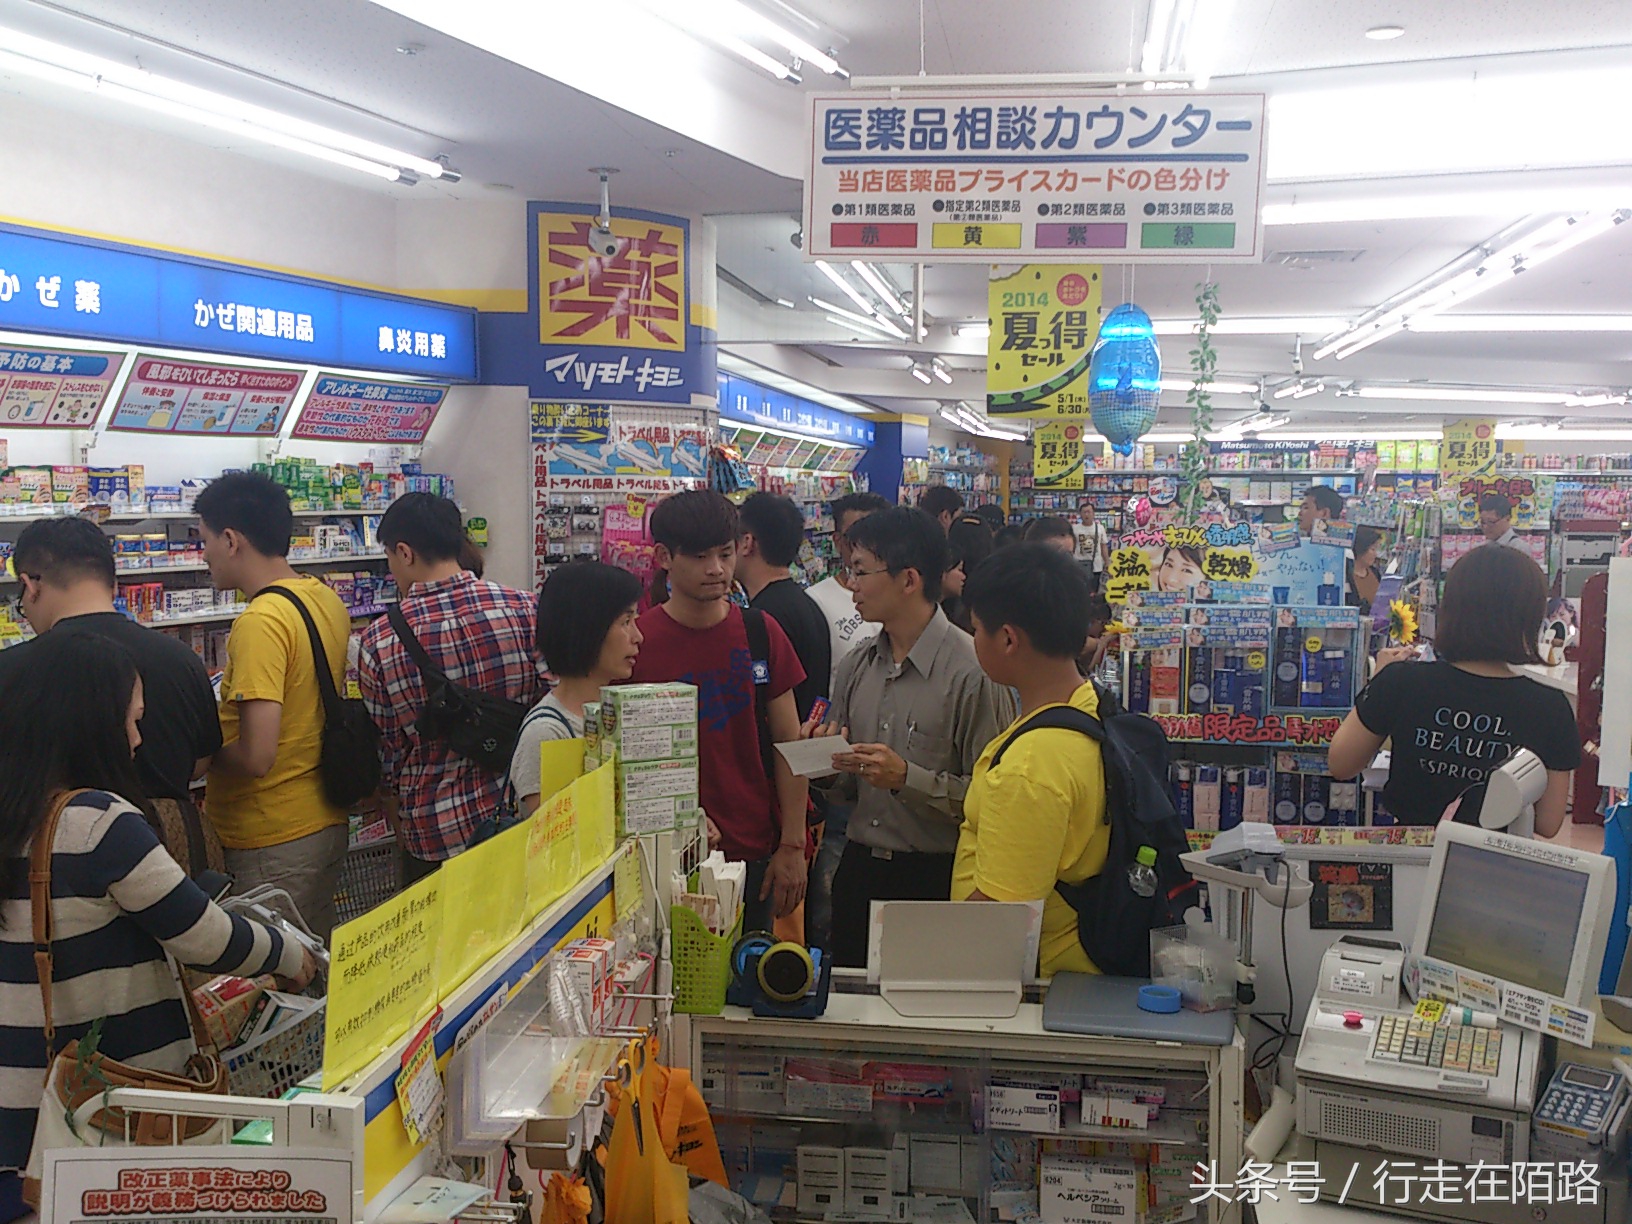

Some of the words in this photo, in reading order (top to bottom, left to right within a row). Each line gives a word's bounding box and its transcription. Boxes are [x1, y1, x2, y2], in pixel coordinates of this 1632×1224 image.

[824, 104, 1253, 151] 医薬品相談カウンター
[837, 168, 1231, 193] 当店医薬品プライスカードの色分け
[861, 225, 880, 245] 赤
[963, 225, 983, 246] 黄
[1066, 225, 1087, 246] 紫
[1173, 225, 1194, 246] 緑
[548, 221, 679, 344] 薬
[1001, 291, 1049, 308] 2014
[194, 299, 314, 343] かぜ関連用品
[1000, 311, 1088, 350] 夏っ得
[378, 326, 447, 359] 鼻炎用薬
[1021, 353, 1066, 367] セール
[146, 363, 239, 387] 風邪をひいてしまったら
[545, 352, 684, 393] マツモトキヨシ
[322, 380, 389, 400] アレルギー性鼻炎
[550, 478, 614, 490] トラベル用品
[1207, 551, 1252, 579] 乾燥
[1203, 713, 1286, 743] 限定品
[1434, 706, 1513, 736] COOL.
[1414, 727, 1521, 759] BEAUTY
[121, 1170, 290, 1189] 改正薬事法により
[86, 1191, 325, 1212] 説明が義務づけられました
